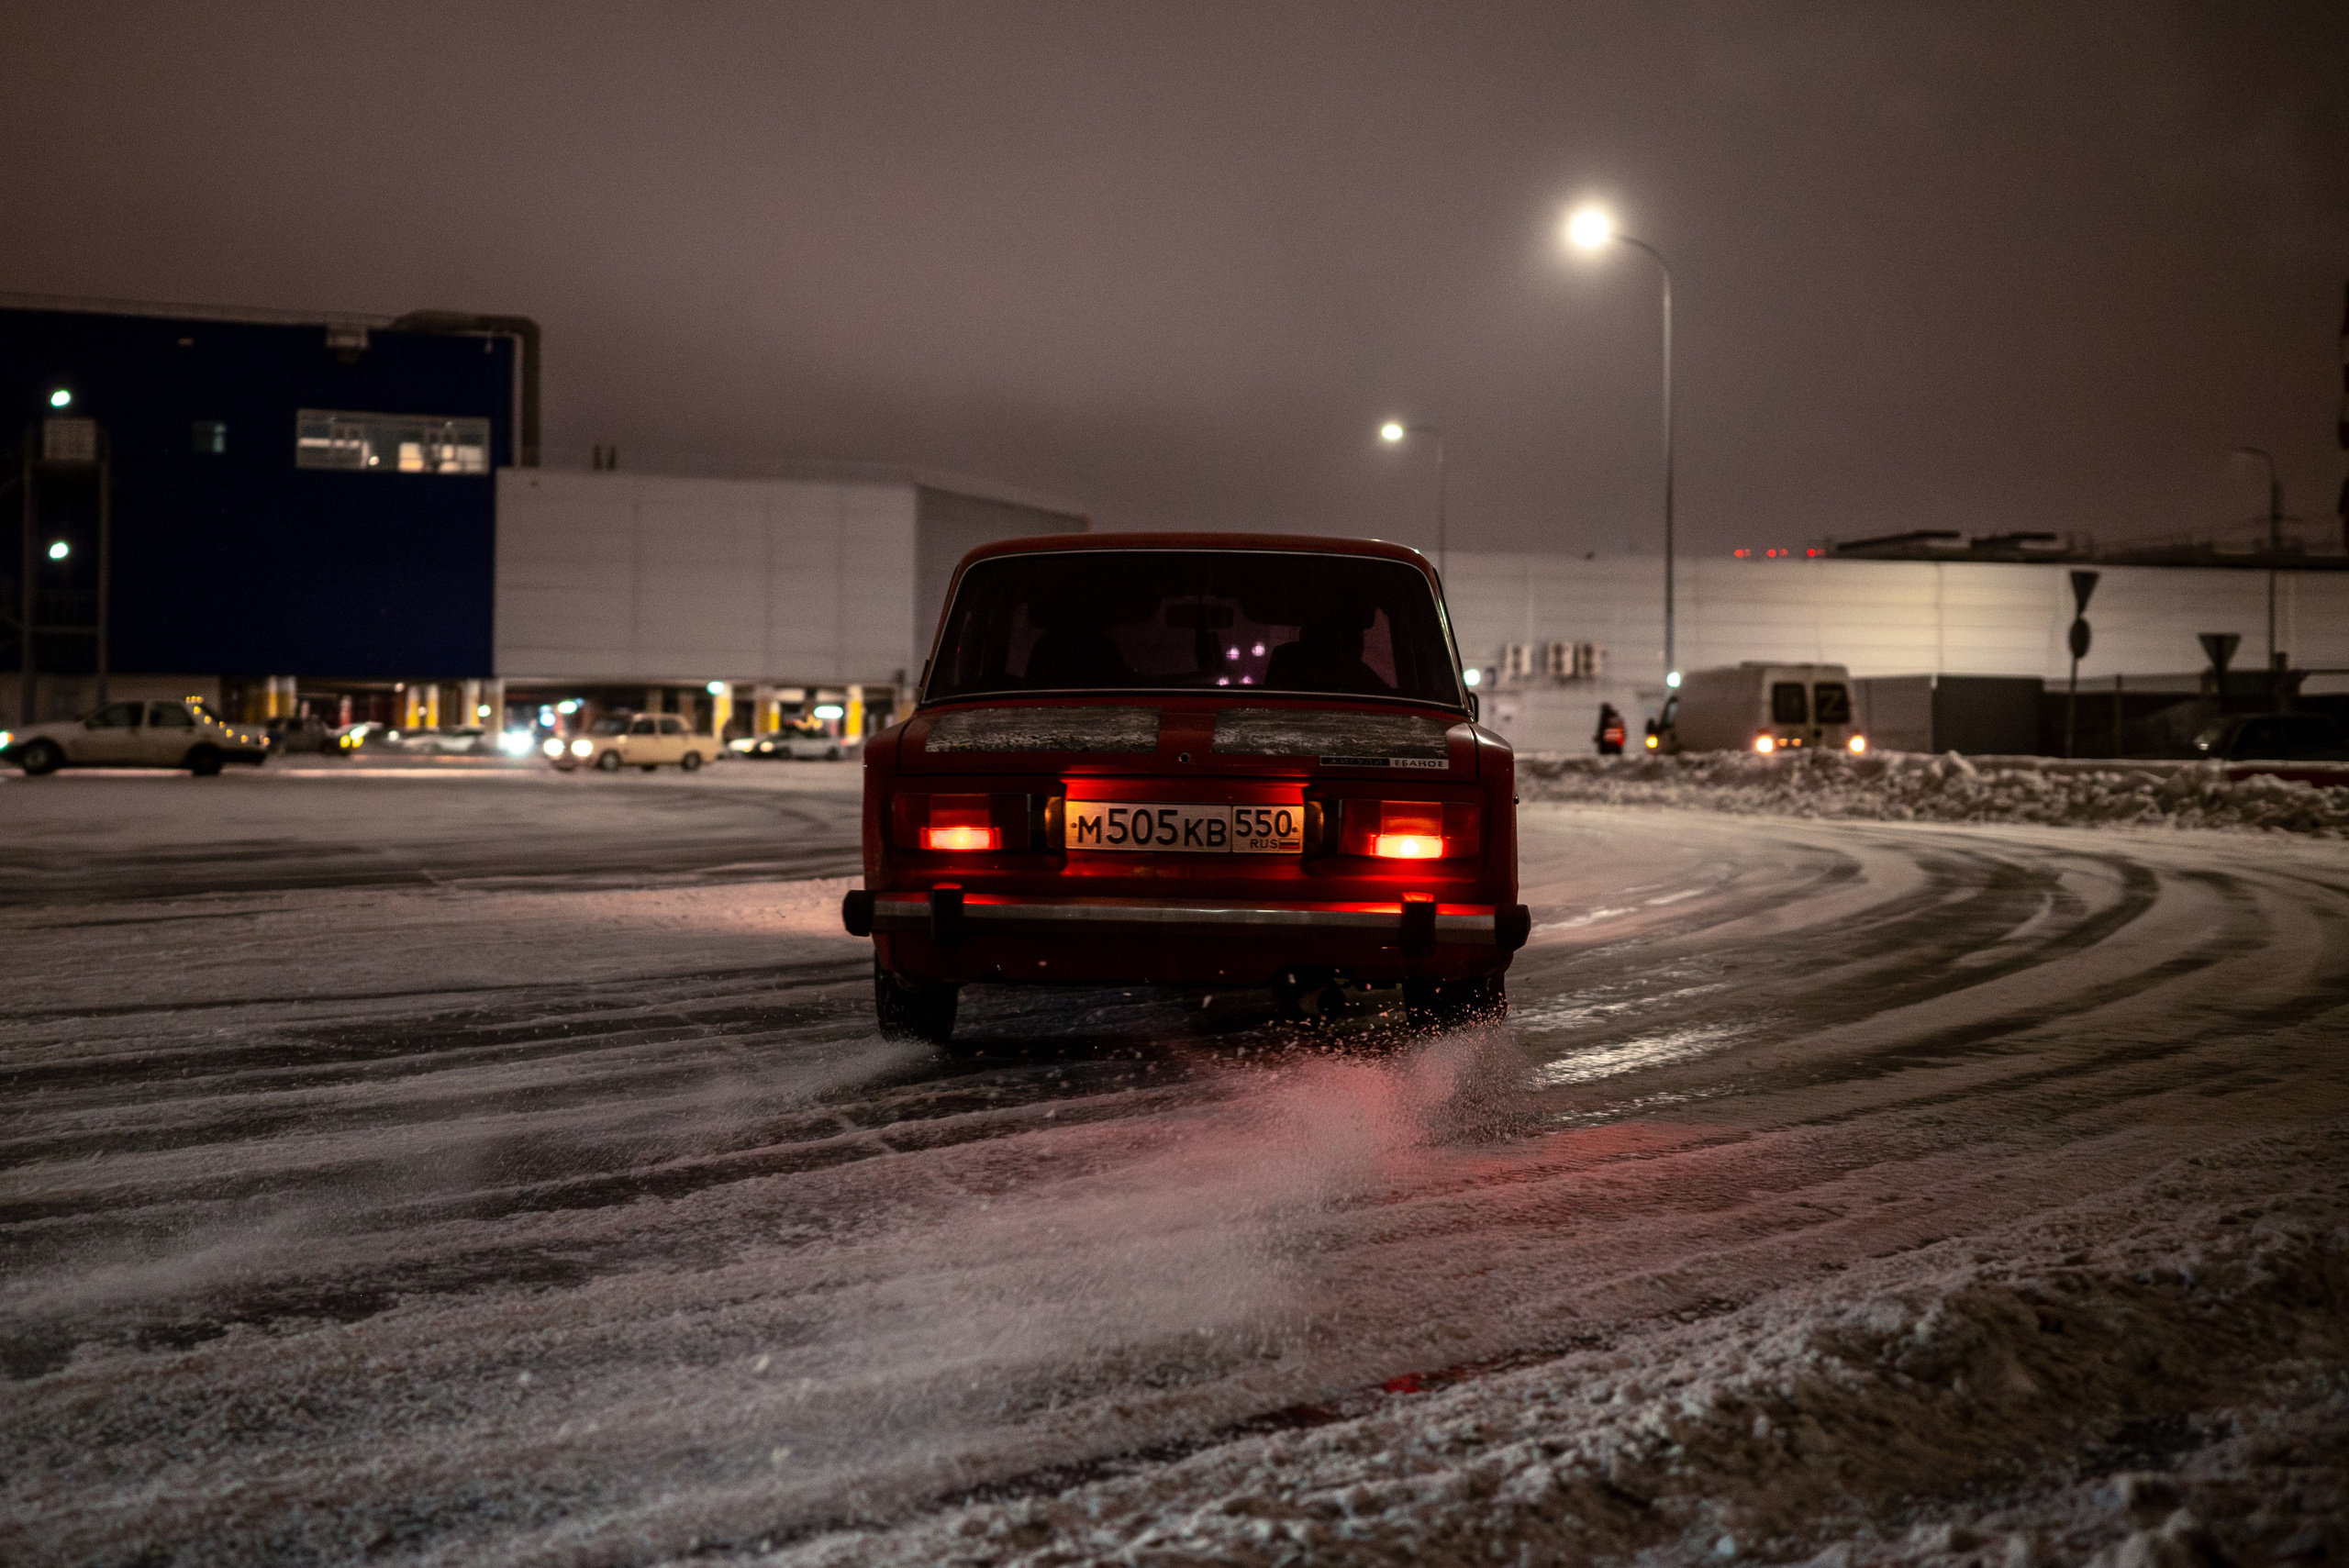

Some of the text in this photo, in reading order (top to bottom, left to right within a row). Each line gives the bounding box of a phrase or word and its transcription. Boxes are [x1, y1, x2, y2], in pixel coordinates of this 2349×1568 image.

[1395, 759, 1443, 768] ЕБАНОЕ
[1235, 809, 1292, 838] 550
[1250, 839, 1278, 850] RUS
